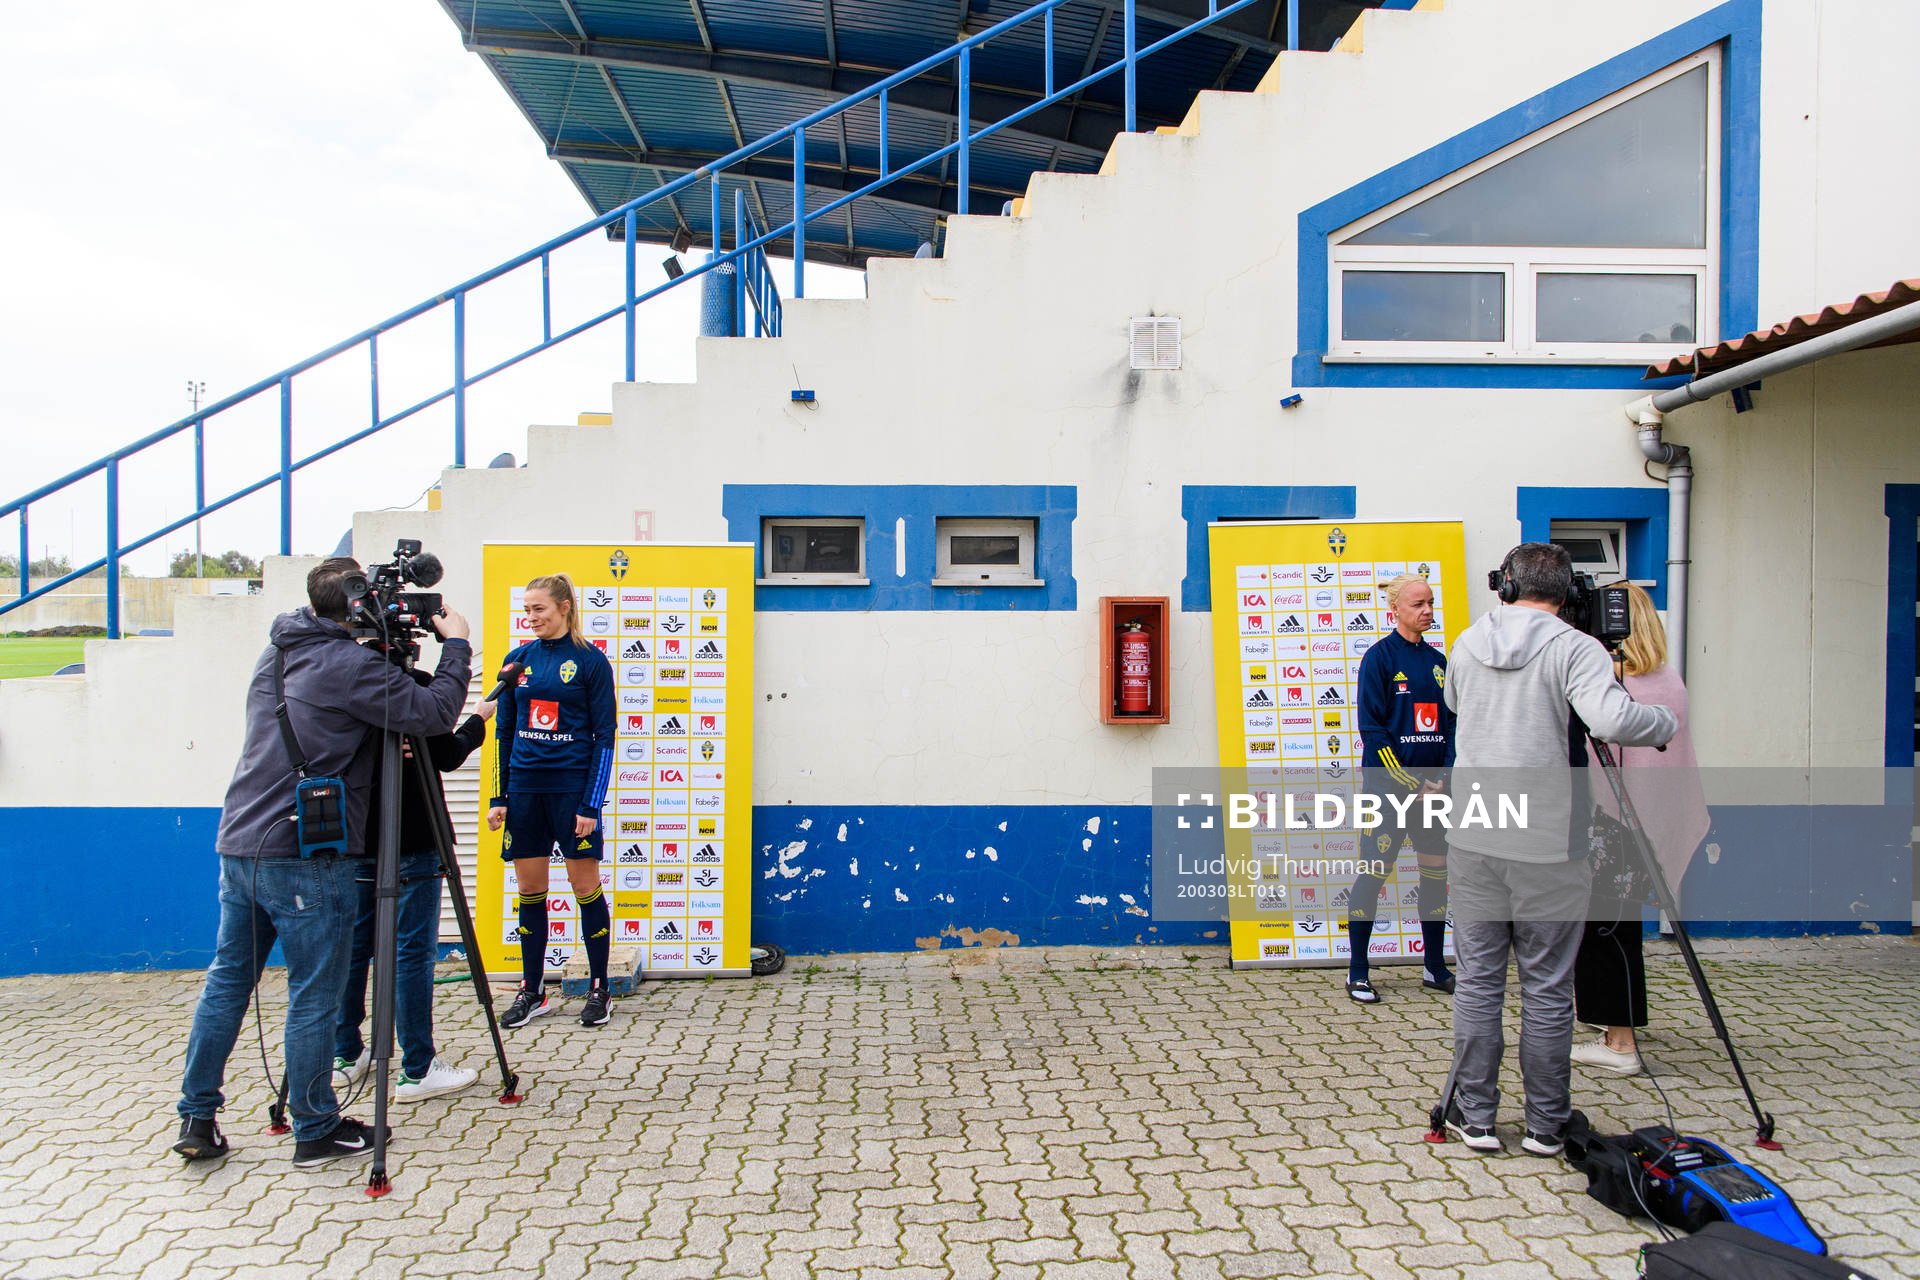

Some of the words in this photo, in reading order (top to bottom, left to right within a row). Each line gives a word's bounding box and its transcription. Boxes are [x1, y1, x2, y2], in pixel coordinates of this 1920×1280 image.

[1318, 566, 1326, 574] SJ
[596, 590, 606, 598] SJ
[1346, 592, 1370, 600] SPORT
[1244, 594, 1266, 606] ICA
[624, 618, 650, 627] SPORT
[668, 615, 678, 623] SJ
[516, 618, 530, 630] IC
[1245, 646, 1269, 654] Fabege
[660, 668, 686, 678] SPORT
[1282, 666, 1306, 678] ICA
[1313, 666, 1344, 675] Scandic
[624, 696, 648, 706] Fabege
[1246, 700, 1274, 708] adidas
[1317, 698, 1344, 706] adidas
[1249, 719, 1273, 728] Fabege
[552, 734, 574, 742] SPEL
[1250, 741, 1275, 751] SPORT
[1330, 761, 1340, 769] SJ
[1284, 767, 1316, 775] Scandic
[660, 770, 684, 782] ICA
[695, 798, 719, 807] Fabege
[620, 821, 647, 831] SPORT
[656, 872, 683, 882] SPORT
[702, 869, 711, 878] SJ
[546, 899, 570, 912] ICA
[1264, 945, 1289, 954] SPORT
[1409, 940, 1424, 952] IC
[553, 948, 562, 957] SJ
[701, 947, 710, 955] SJ
